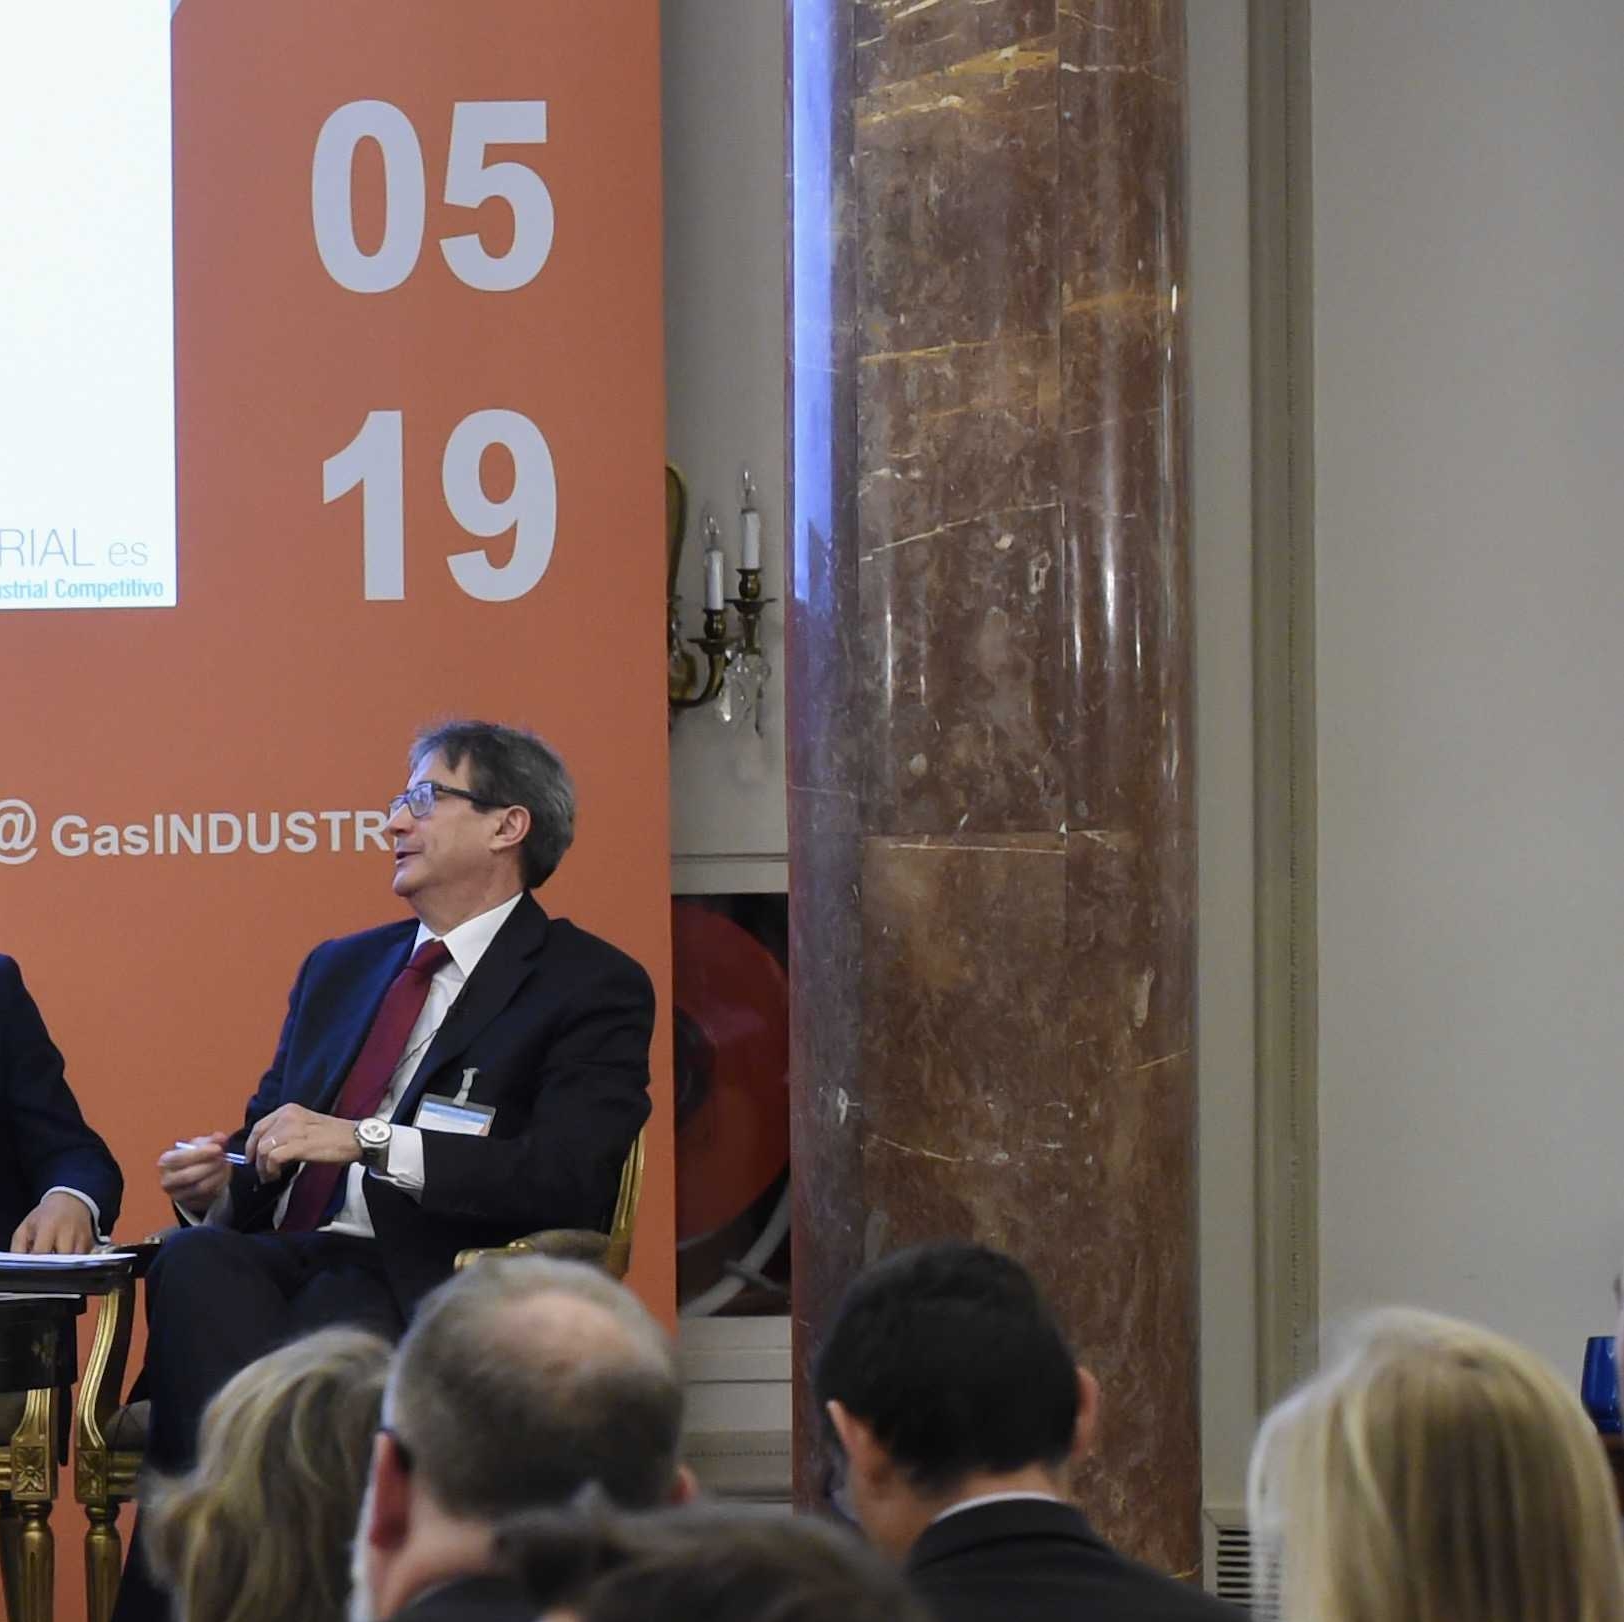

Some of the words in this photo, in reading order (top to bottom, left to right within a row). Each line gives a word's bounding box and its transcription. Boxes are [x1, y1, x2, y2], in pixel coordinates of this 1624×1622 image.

[310, 99, 555, 294] 05
[55, 576, 164, 602] Competitivo
[322, 407, 558, 603] 19
